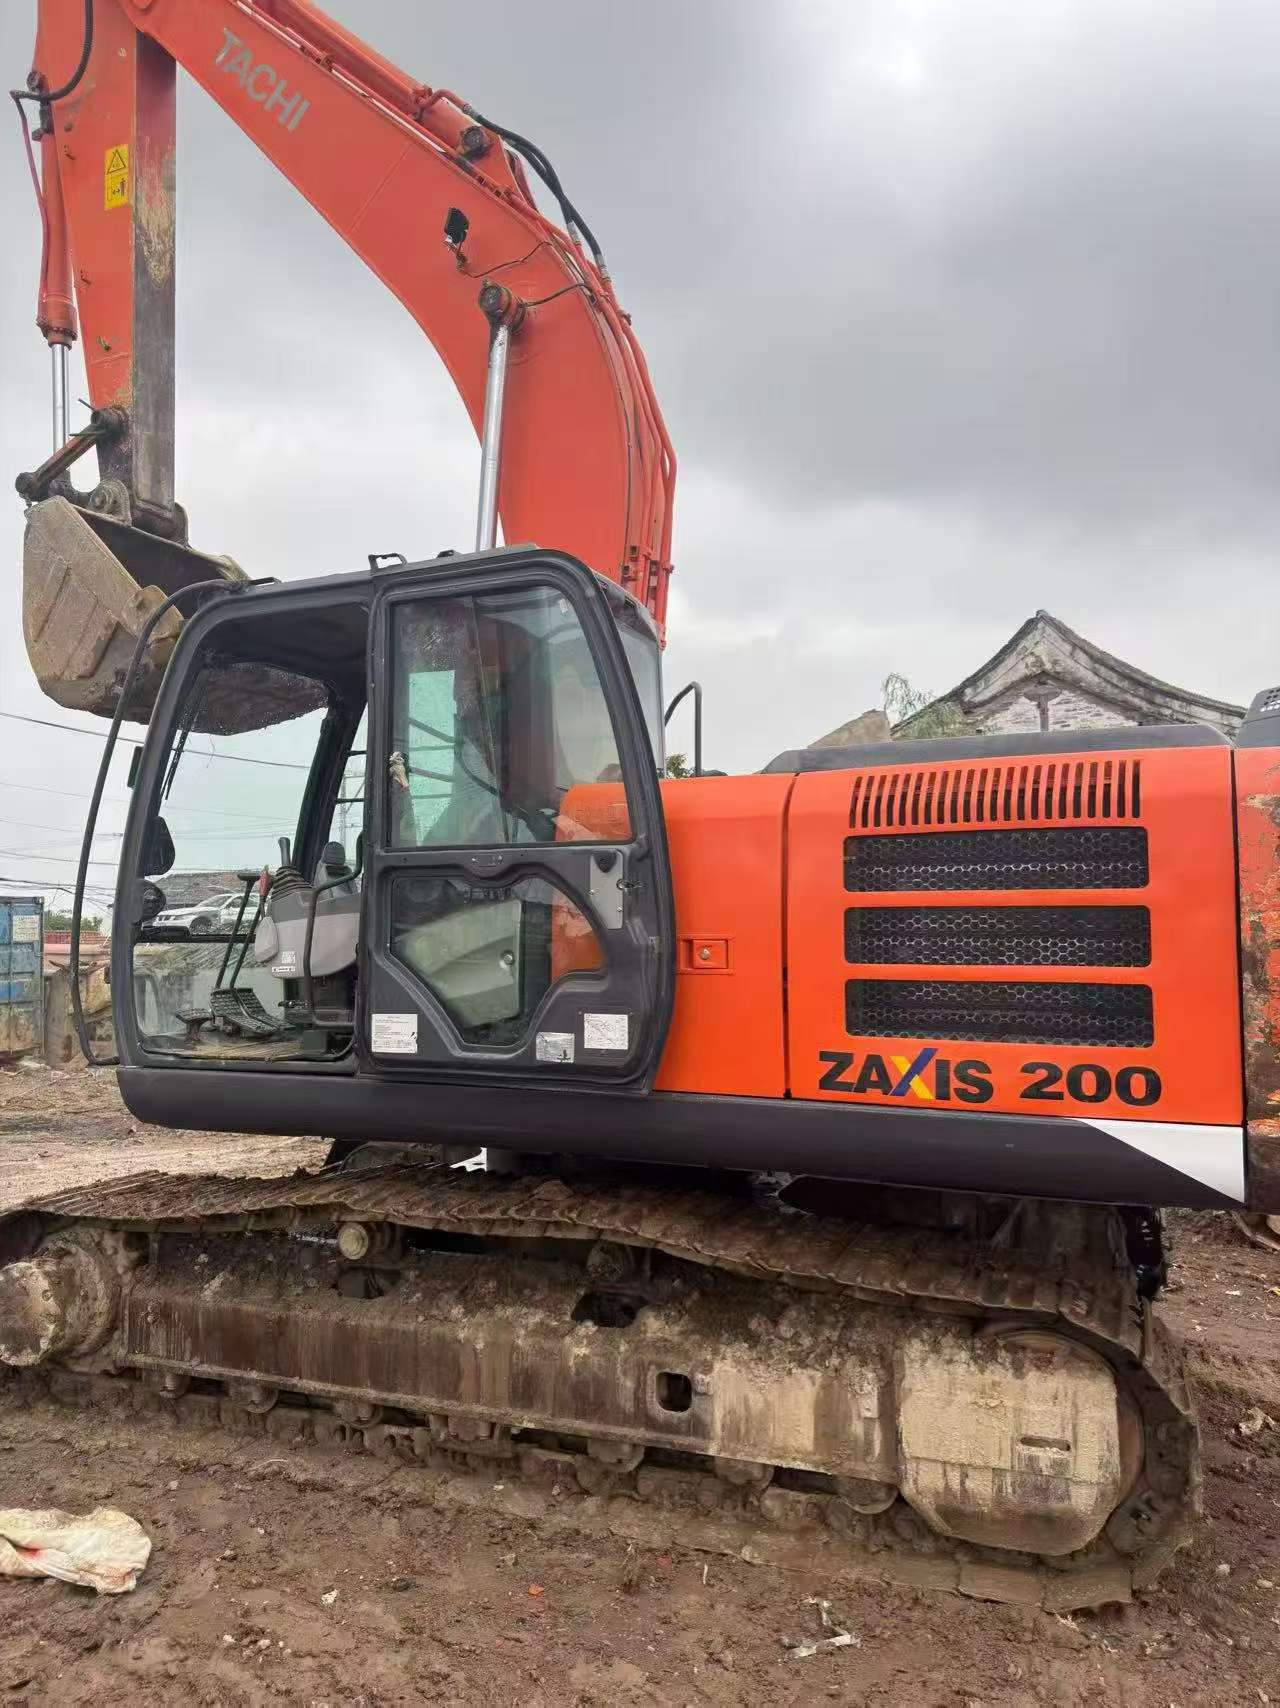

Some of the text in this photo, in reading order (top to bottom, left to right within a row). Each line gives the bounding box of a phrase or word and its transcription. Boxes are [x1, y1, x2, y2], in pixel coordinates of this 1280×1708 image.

[215, 27, 311, 132] TACHI
[818, 1047, 1162, 1107] ZAXIS 200
